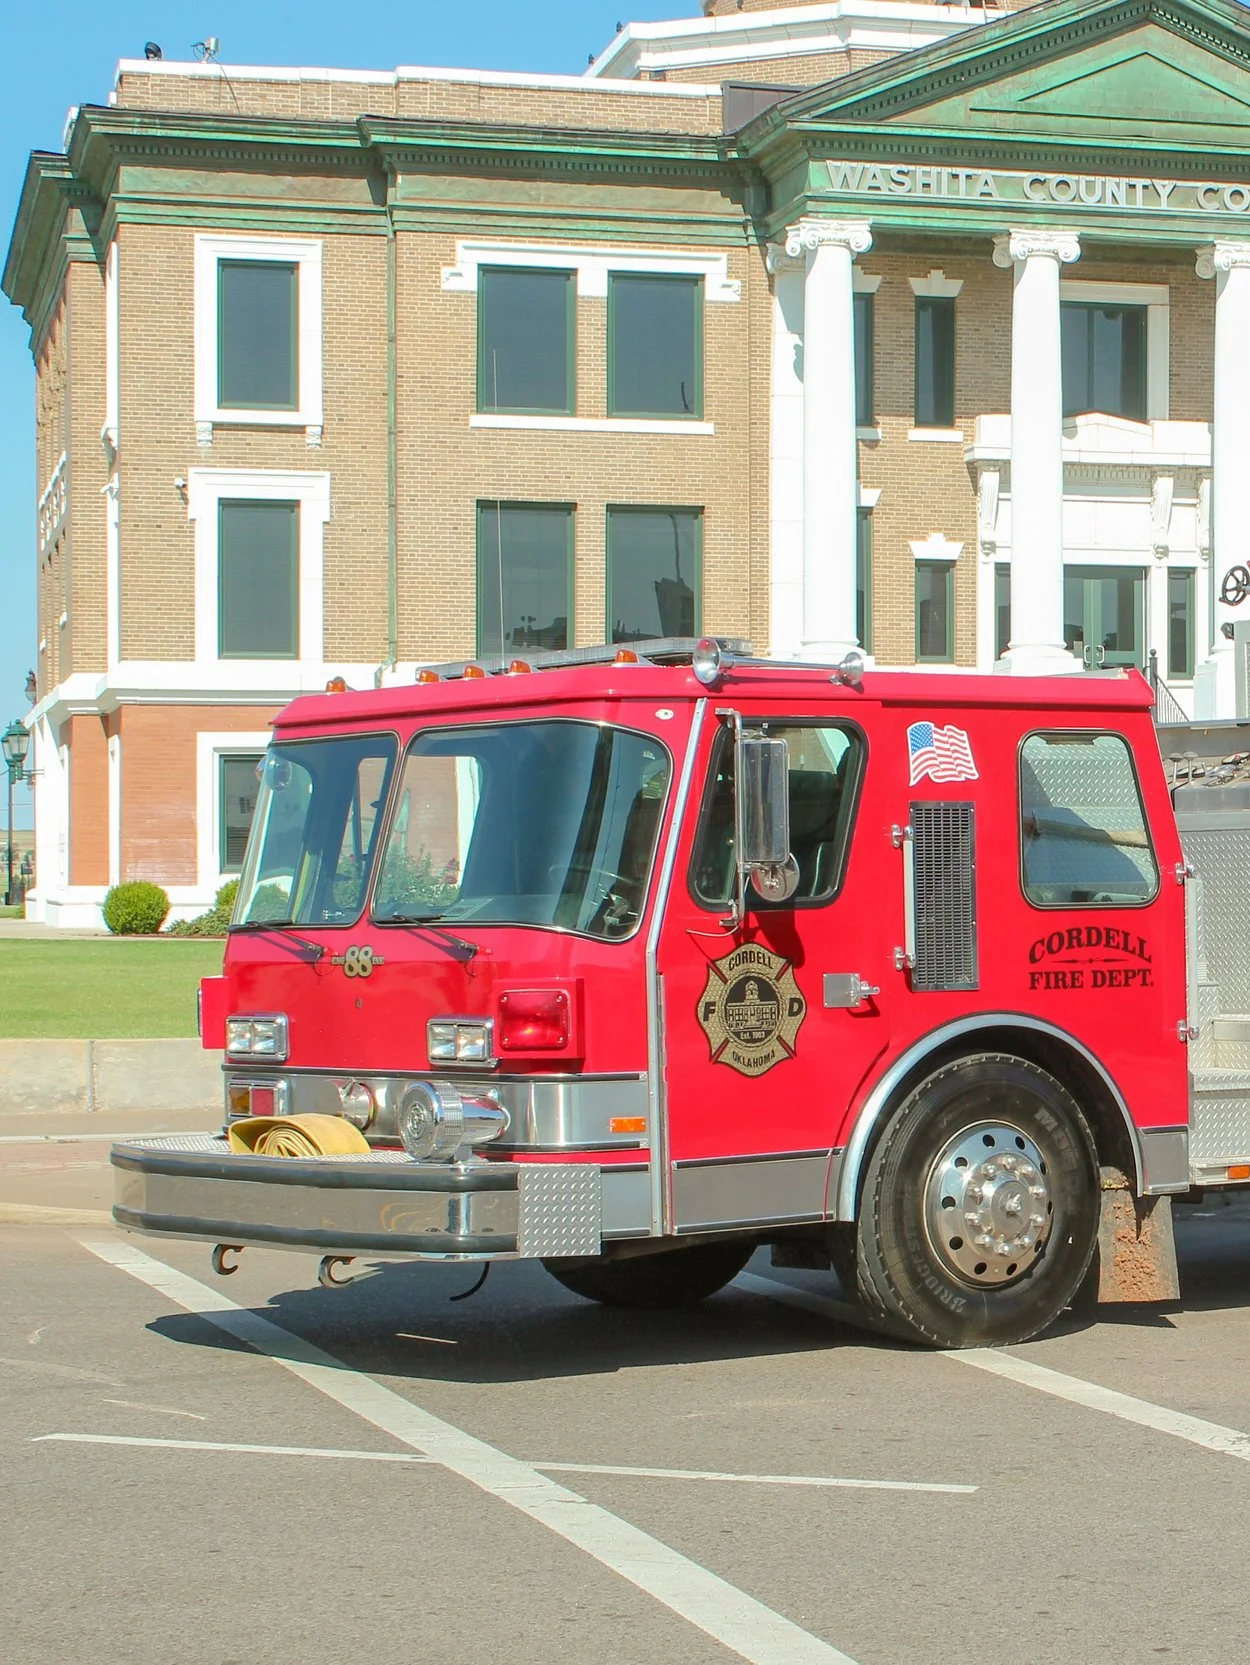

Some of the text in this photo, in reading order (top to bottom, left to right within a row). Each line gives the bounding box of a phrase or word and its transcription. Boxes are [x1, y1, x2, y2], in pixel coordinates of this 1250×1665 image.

[825, 161, 999, 198] WASHITA
[1022, 175, 1177, 209] COUNTY
[1028, 926, 1152, 964] CORDELL
[344, 945, 374, 977] 88
[728, 950, 774, 971] CORDELL
[1028, 969, 1154, 990] FIRE DEPT.
[702, 997, 804, 1022] F D
[732, 1049, 776, 1068] OKLAHOMA
